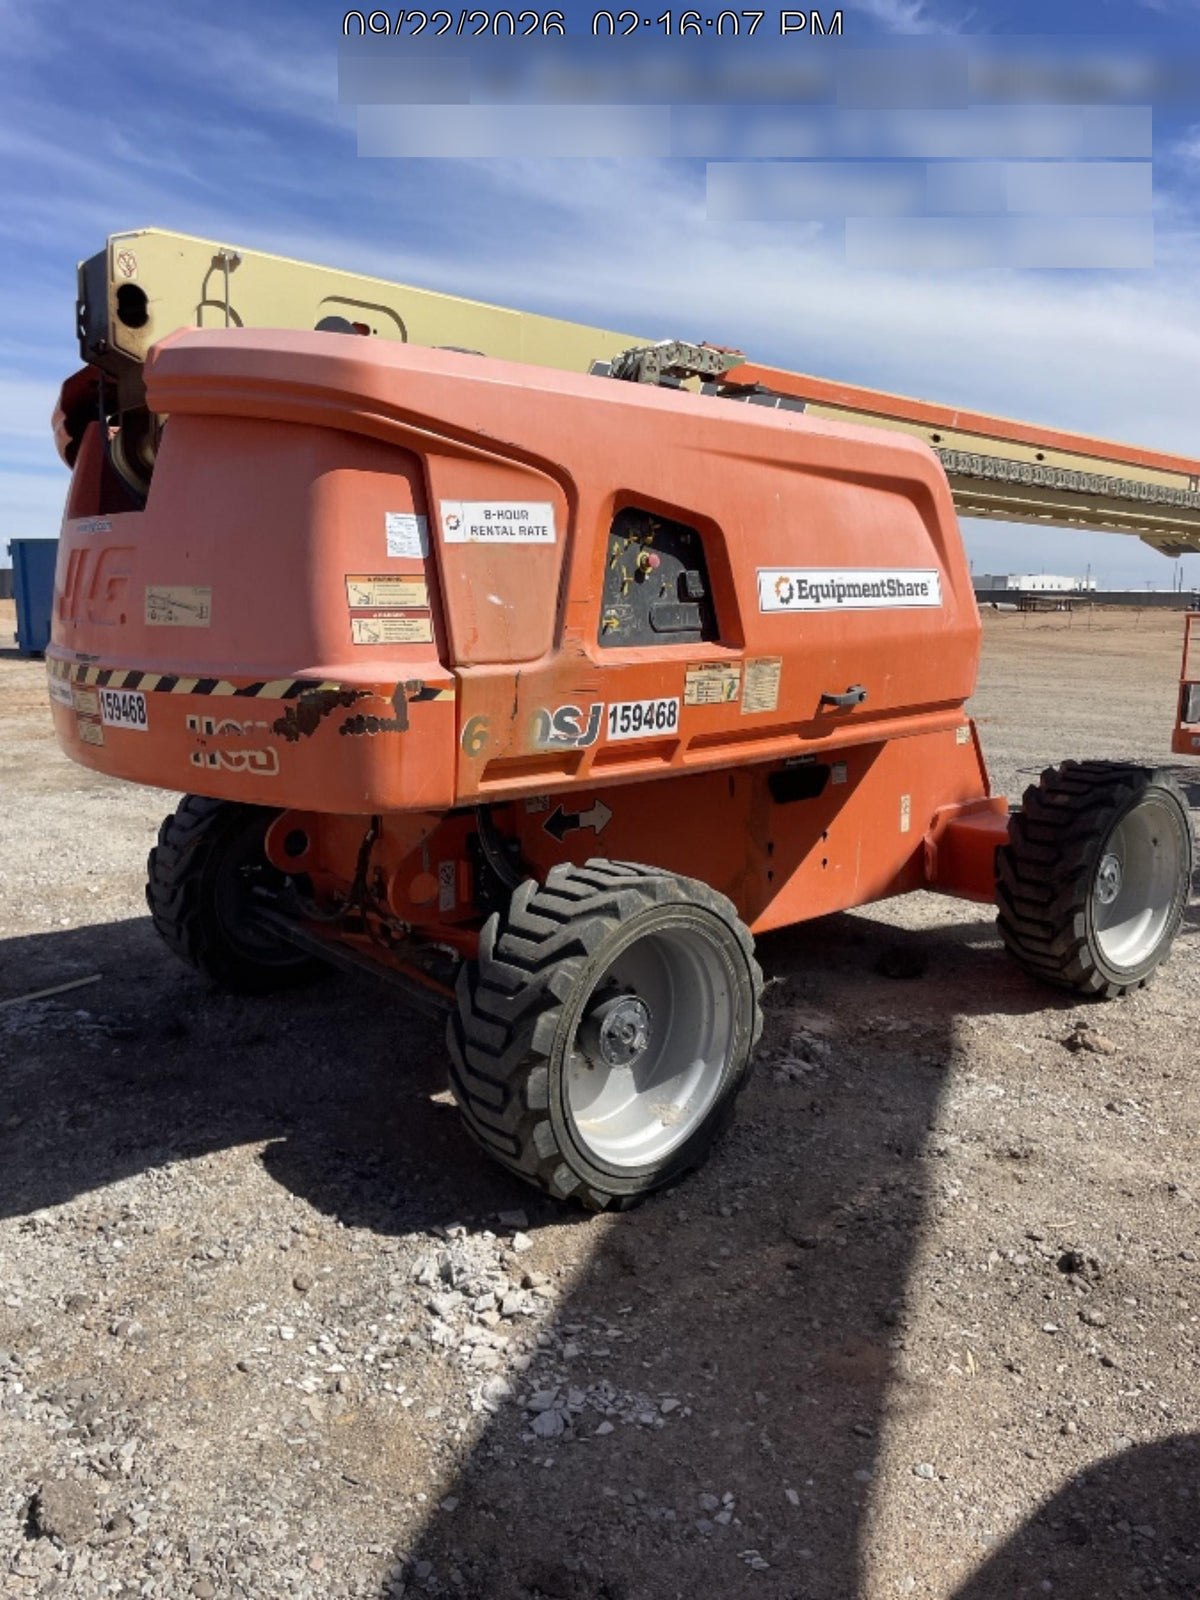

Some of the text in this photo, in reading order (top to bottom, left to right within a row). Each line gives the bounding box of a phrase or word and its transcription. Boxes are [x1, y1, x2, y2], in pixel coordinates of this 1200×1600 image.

[484, 510, 529, 521] 8-HOUR
[470, 525, 549, 537] RENTAL RATE
[797, 578, 930, 604] EquipmentShare
[100, 691, 146, 725] 159468
[609, 700, 677, 735] 159468
